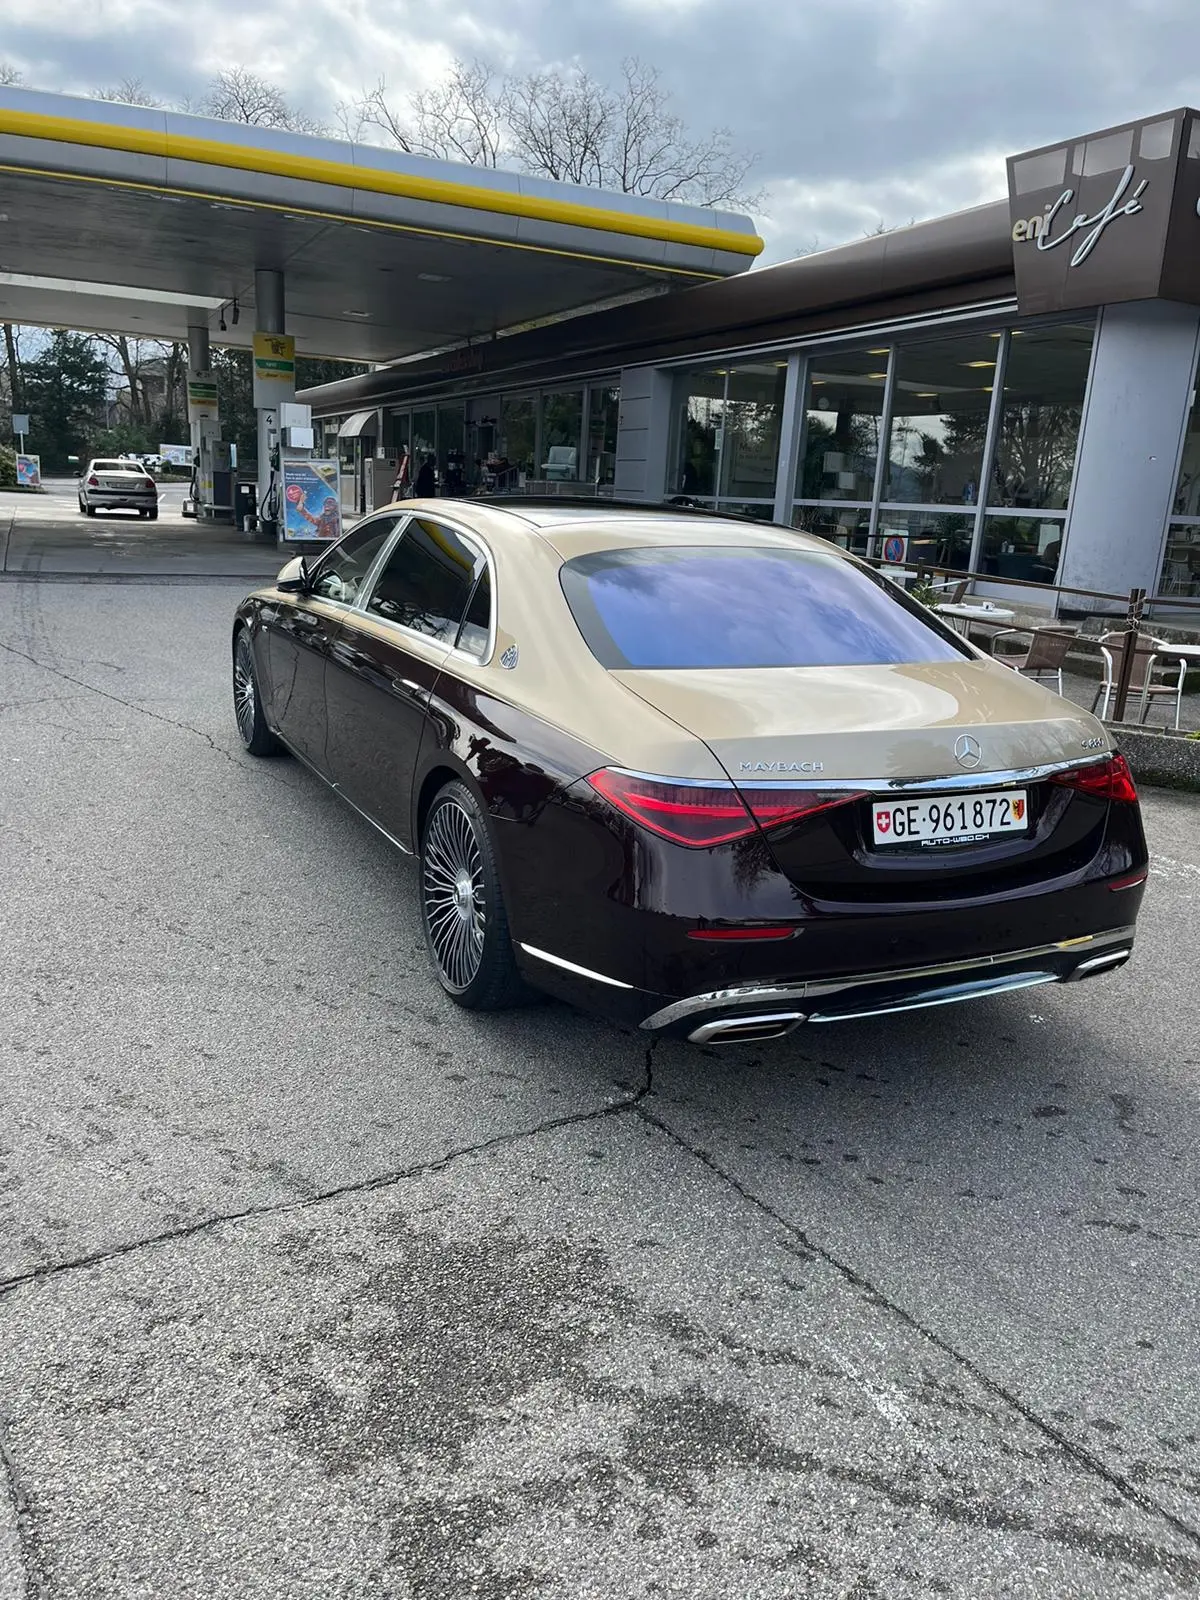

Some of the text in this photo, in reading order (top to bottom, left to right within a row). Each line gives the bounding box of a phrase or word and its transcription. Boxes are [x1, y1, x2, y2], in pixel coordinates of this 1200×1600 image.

[1012, 164, 1150, 267] eni Café
[266, 415, 273, 425] 4
[740, 761, 824, 773] MAYBACH
